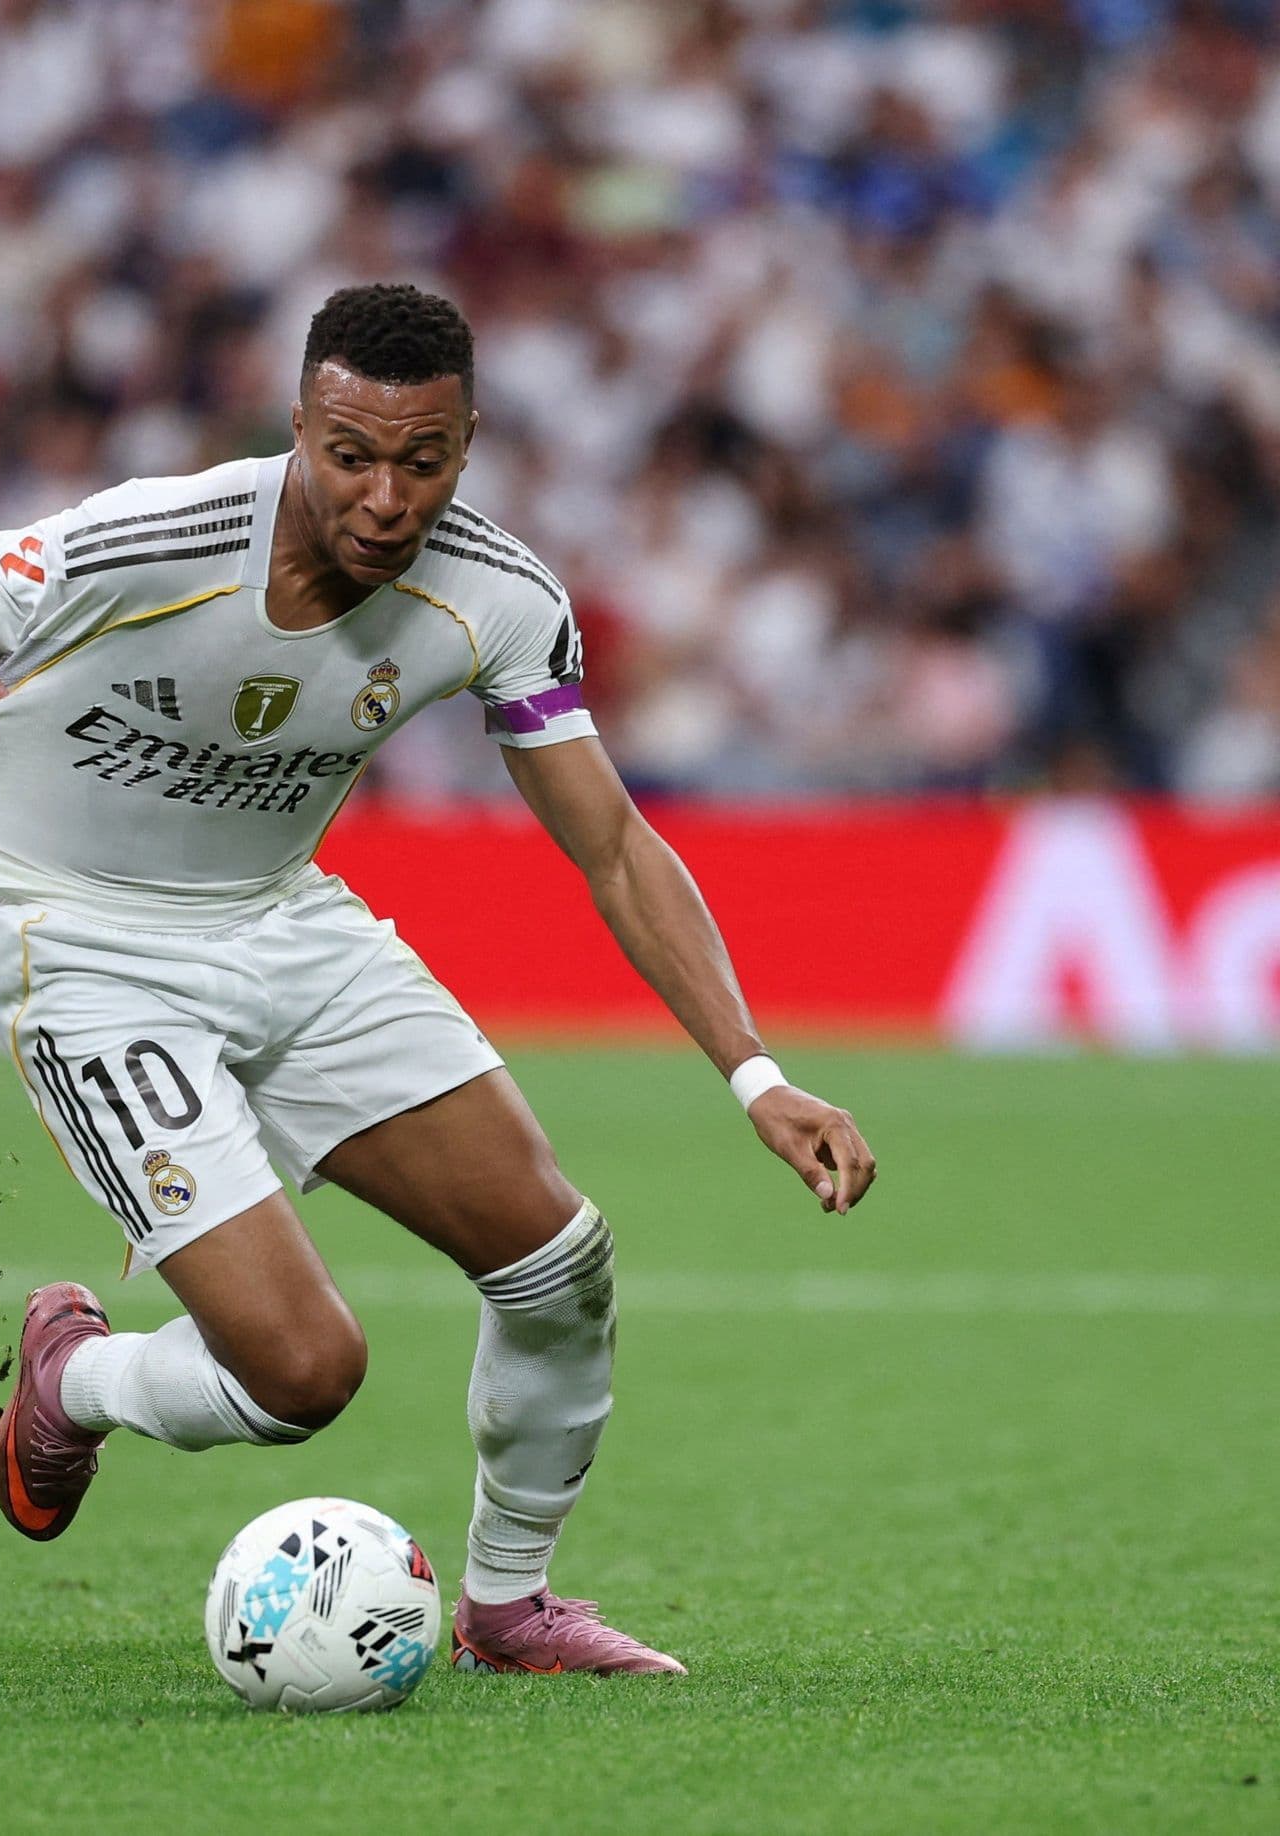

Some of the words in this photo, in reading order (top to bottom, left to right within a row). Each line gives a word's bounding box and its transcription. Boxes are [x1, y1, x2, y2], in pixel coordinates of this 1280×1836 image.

[65, 705, 368, 779] Emirates
[73, 750, 162, 788] FLY
[163, 776, 310, 814] BETTER
[82, 1039, 202, 1150] 10
